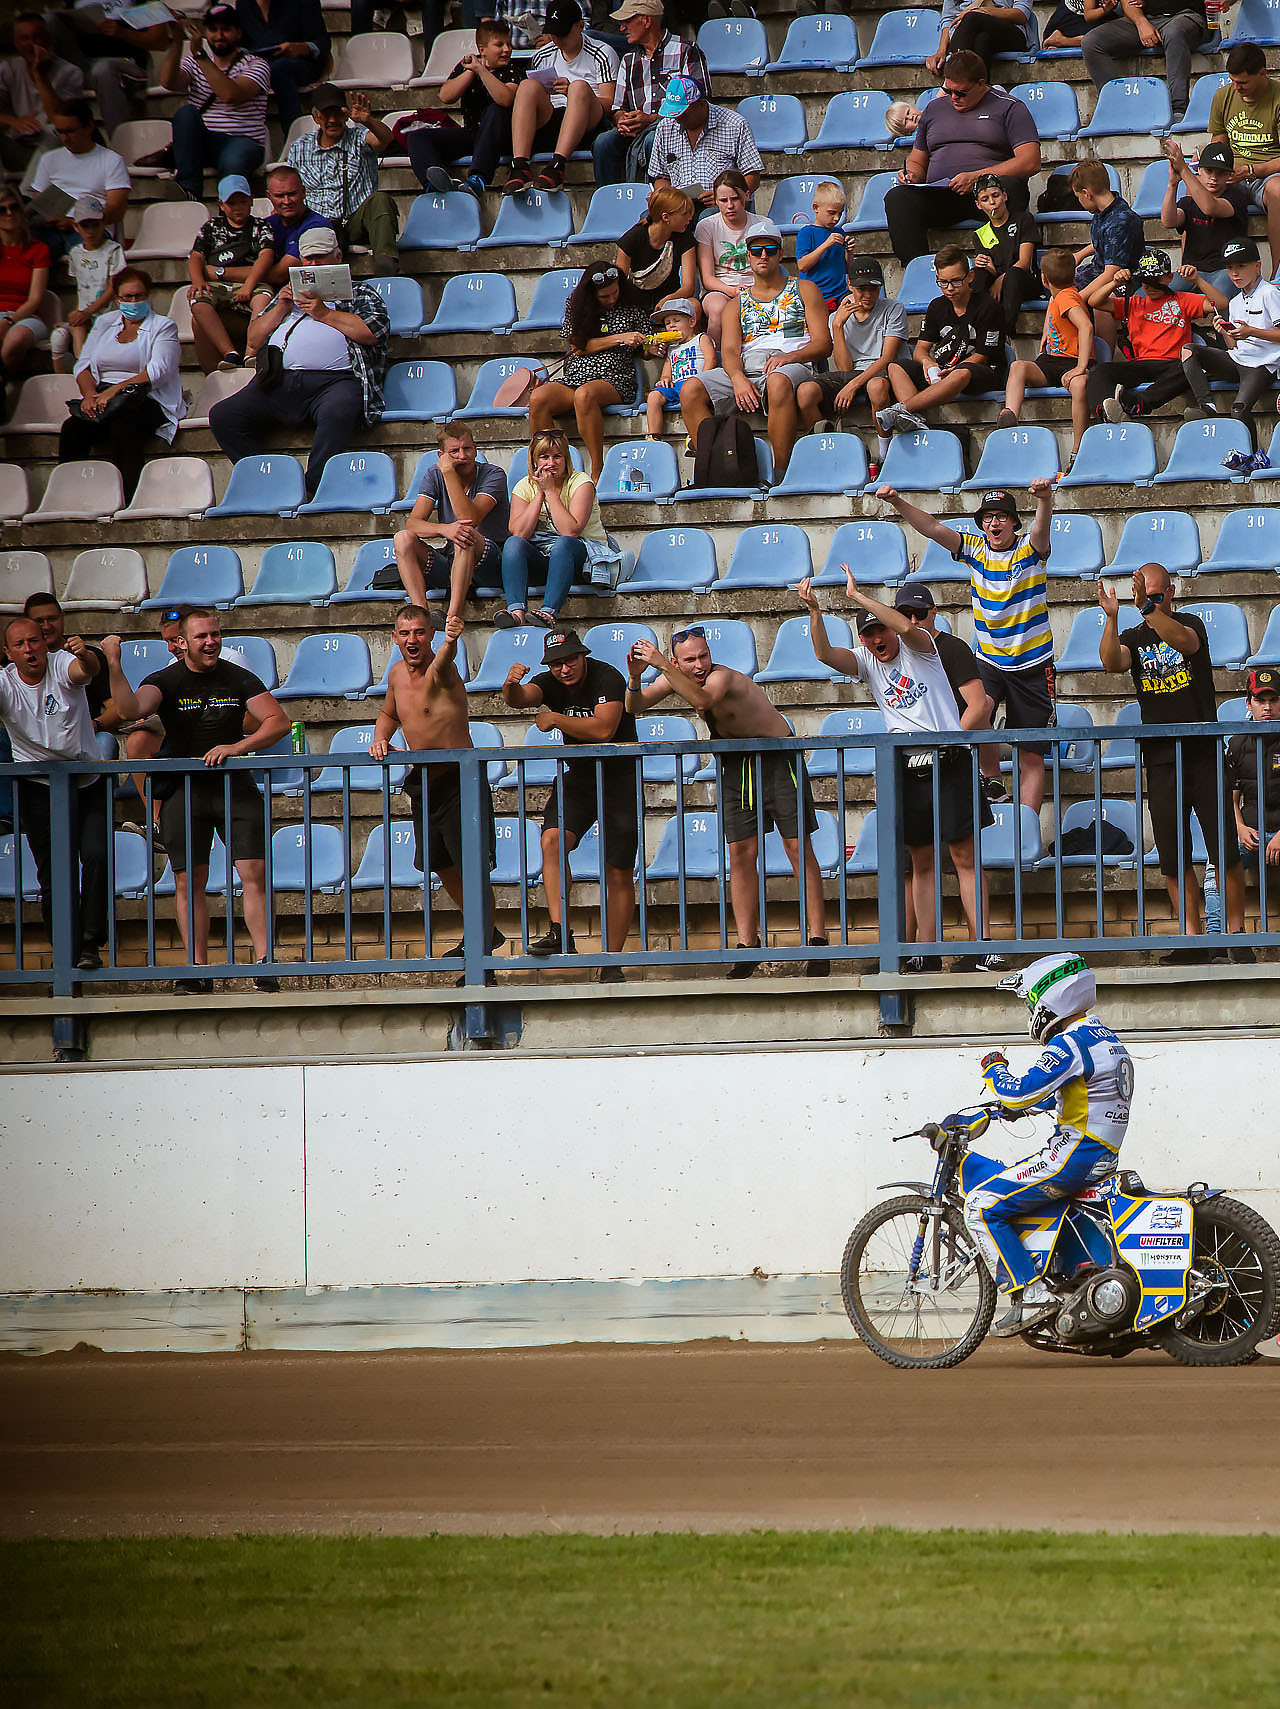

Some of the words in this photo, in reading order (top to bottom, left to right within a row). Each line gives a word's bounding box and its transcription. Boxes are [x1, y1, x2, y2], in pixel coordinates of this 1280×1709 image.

[817, 21, 830, 32] 38
[906, 16, 917, 27] 37
[725, 24, 742, 35] 39
[1029, 88, 1043, 100] 35
[1125, 83, 1139, 95] 34
[760, 101, 776, 112] 38
[853, 96, 868, 108] 37
[800, 182, 813, 193] 37
[527, 195, 542, 206] 40
[617, 189, 633, 200] 39
[433, 198, 444, 210] 41
[468, 279, 482, 290] 40
[1144, 309, 1186, 328] adidas
[408, 367, 423, 378] 40
[499, 365, 515, 376] 39
[1107, 429, 1126, 440] 32
[1203, 425, 1215, 437] 31
[821, 438, 834, 450] 35
[914, 434, 928, 446] 34
[1012, 432, 1028, 444] 33
[632, 448, 647, 459] 37
[261, 462, 270, 473] 41
[350, 459, 365, 471] 40
[1055, 520, 1070, 532] 32
[1151, 519, 1165, 530] 31
[1248, 516, 1264, 527] 30
[669, 534, 684, 546] 36
[763, 532, 778, 544] 35
[858, 528, 873, 540] 34
[195, 553, 207, 564] 41
[288, 549, 303, 560] 40
[514, 634, 528, 646] 37
[612, 630, 624, 642] 36
[707, 629, 721, 641] 35
[134, 645, 147, 657] 41
[324, 640, 338, 651] 39
[650, 724, 664, 736] 35
[848, 718, 861, 730] 33
[359, 732, 371, 743] 38
[497, 826, 511, 838] 36
[693, 820, 706, 832] 34
[395, 832, 410, 844] 37
[1119, 1062, 1132, 1093] 3
[1140, 1237, 1183, 1246] UNIFILTER
